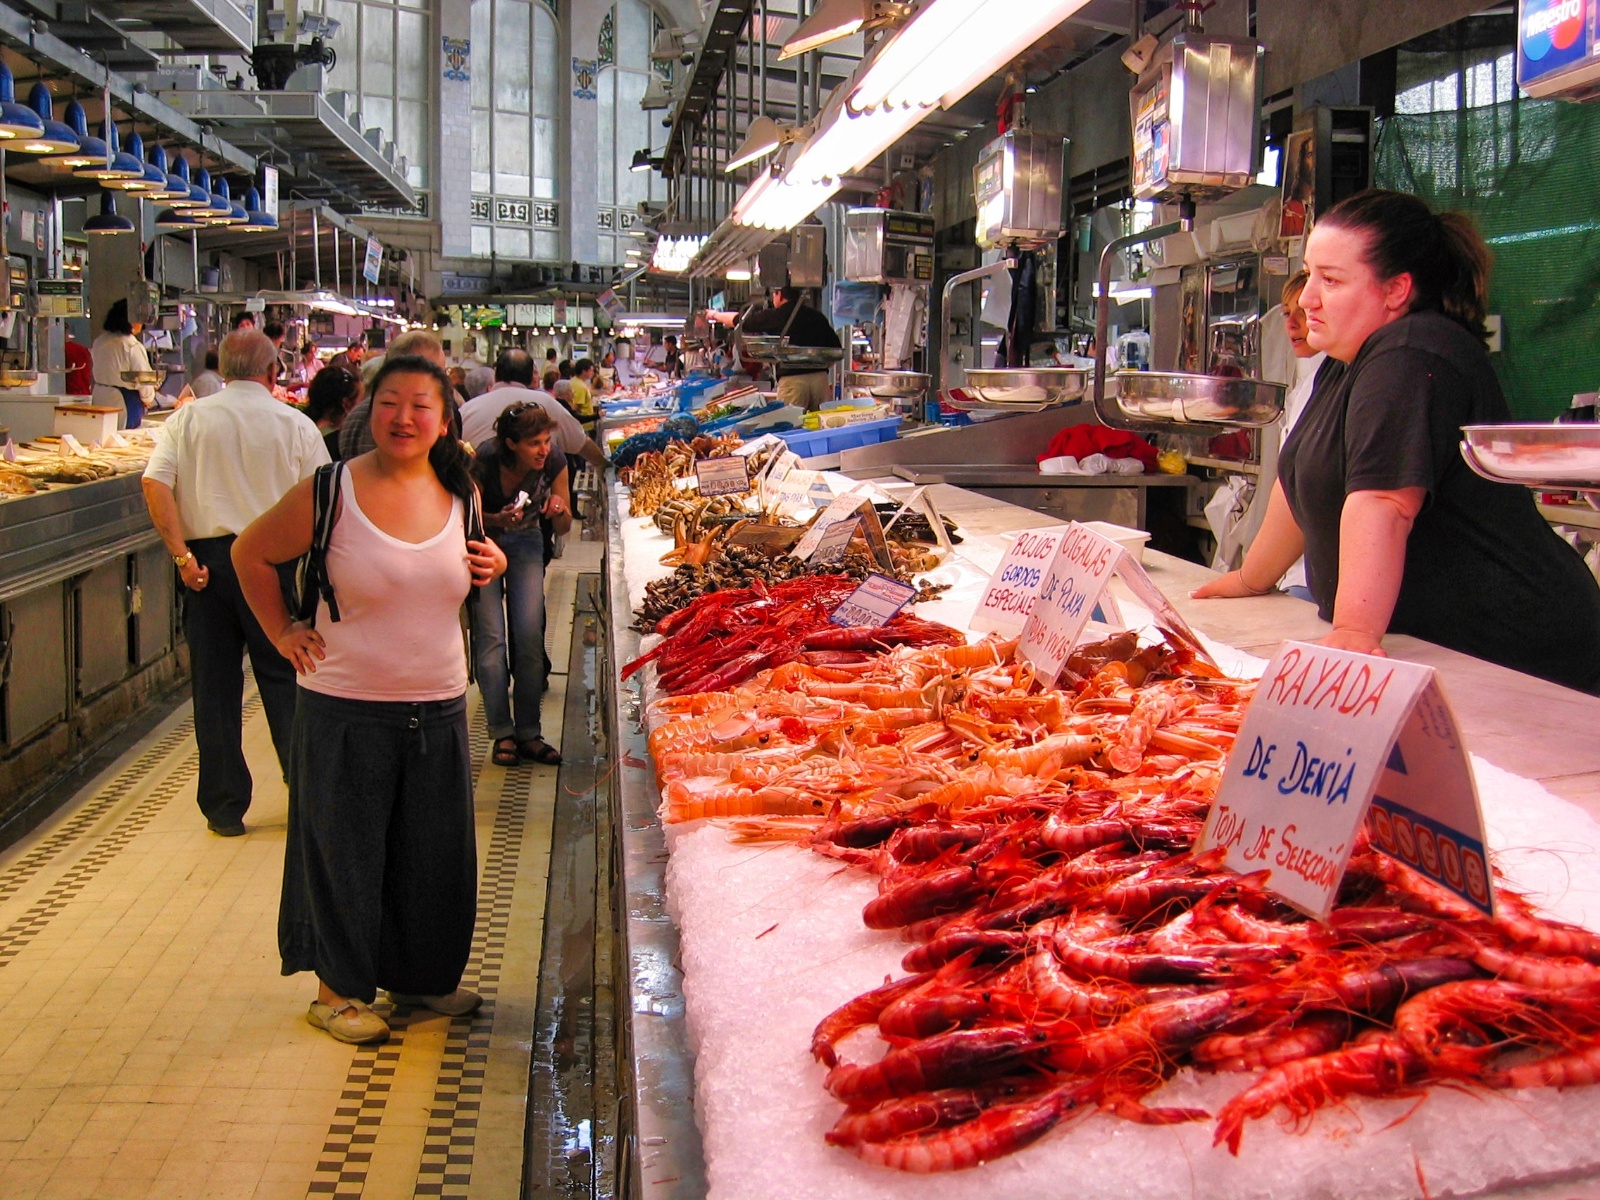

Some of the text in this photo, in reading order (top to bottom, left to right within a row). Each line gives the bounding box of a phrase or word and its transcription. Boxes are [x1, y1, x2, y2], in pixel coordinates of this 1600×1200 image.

[1526, 0, 1580, 38] Maestro
[1011, 532, 1056, 559] ROJOS
[1062, 528, 1111, 577] CIGALAS
[1001, 564, 1041, 588] GORDOS
[1041, 573, 1086, 617] DE PLAYA
[985, 588, 1037, 616] ESPECIALE
[1266, 648, 1395, 717] RAYADA
[1242, 736, 1277, 780] DE
[1211, 806, 1246, 848] TODA
[1243, 825, 1275, 860] DE
